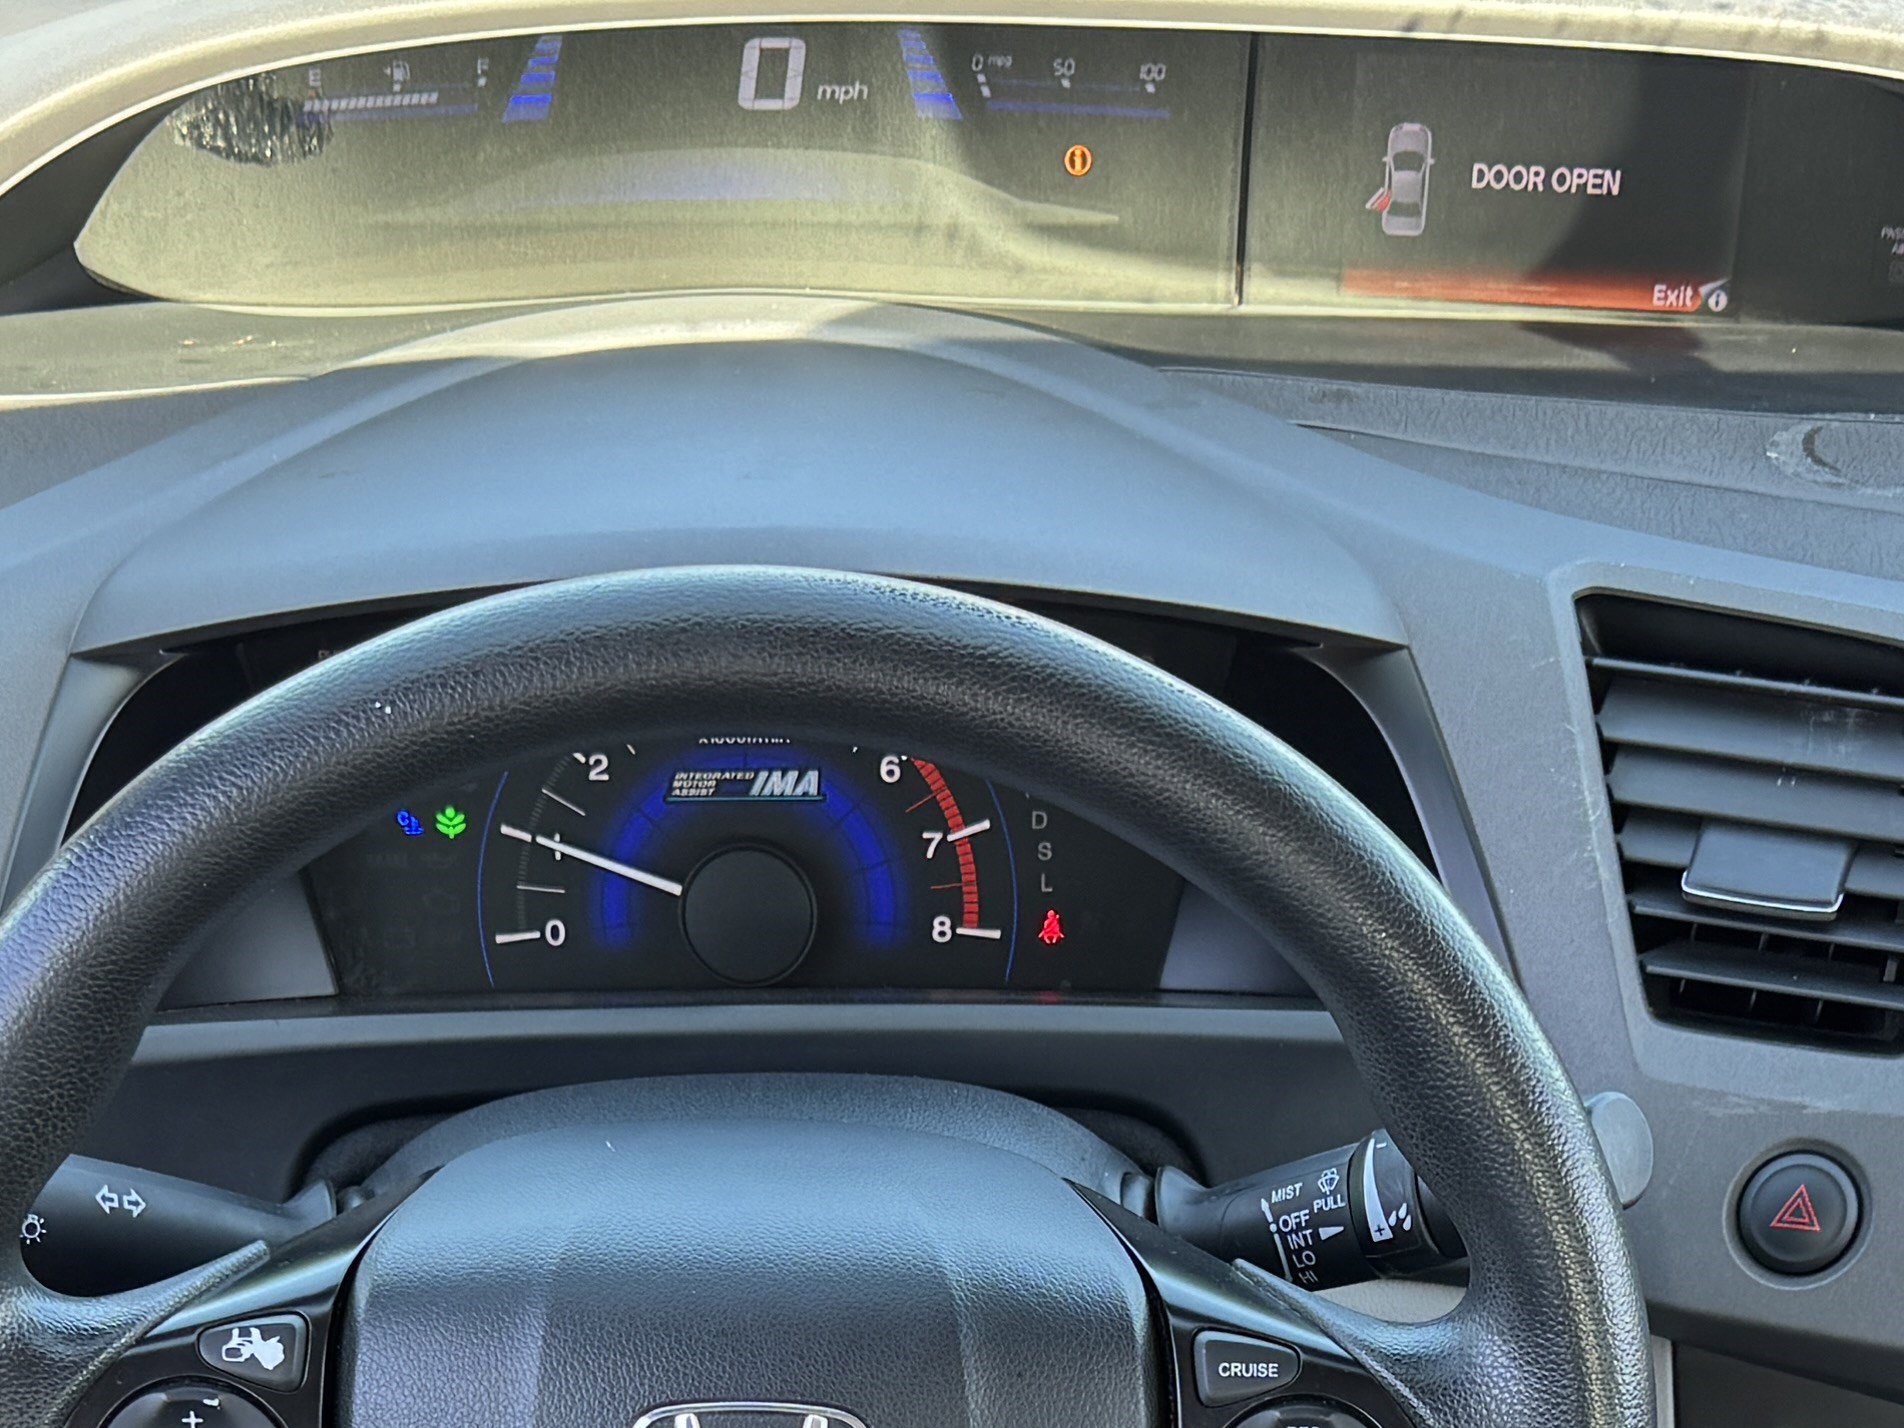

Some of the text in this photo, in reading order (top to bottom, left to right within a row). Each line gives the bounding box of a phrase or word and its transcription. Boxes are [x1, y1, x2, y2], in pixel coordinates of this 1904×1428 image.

[737, 36, 806, 111] 0
[971, 53, 985, 72] 0
[1053, 58, 1076, 76] 50
[1140, 63, 1167, 81] 100
[816, 80, 869, 103] mph
[1470, 162, 1622, 196] DOOR OPEN
[1652, 283, 1694, 308] Exit
[588, 753, 610, 782] 2
[879, 754, 902, 784] 6
[748, 769, 820, 797] IMA
[1031, 810, 1048, 830] D
[922, 830, 943, 860] 7
[1037, 841, 1053, 861] S
[1040, 872, 1054, 893] L
[544, 918, 567, 947] 0
[931, 914, 953, 944] 8
[1270, 1181, 1304, 1205] MIST
[1312, 1193, 1347, 1214] PULL
[1278, 1208, 1311, 1234] OFF
[1286, 1228, 1314, 1250] INT
[1291, 1250, 1317, 1268] LO
[1298, 1270, 1319, 1285] HI
[1218, 1361, 1279, 1378] CRUISE
